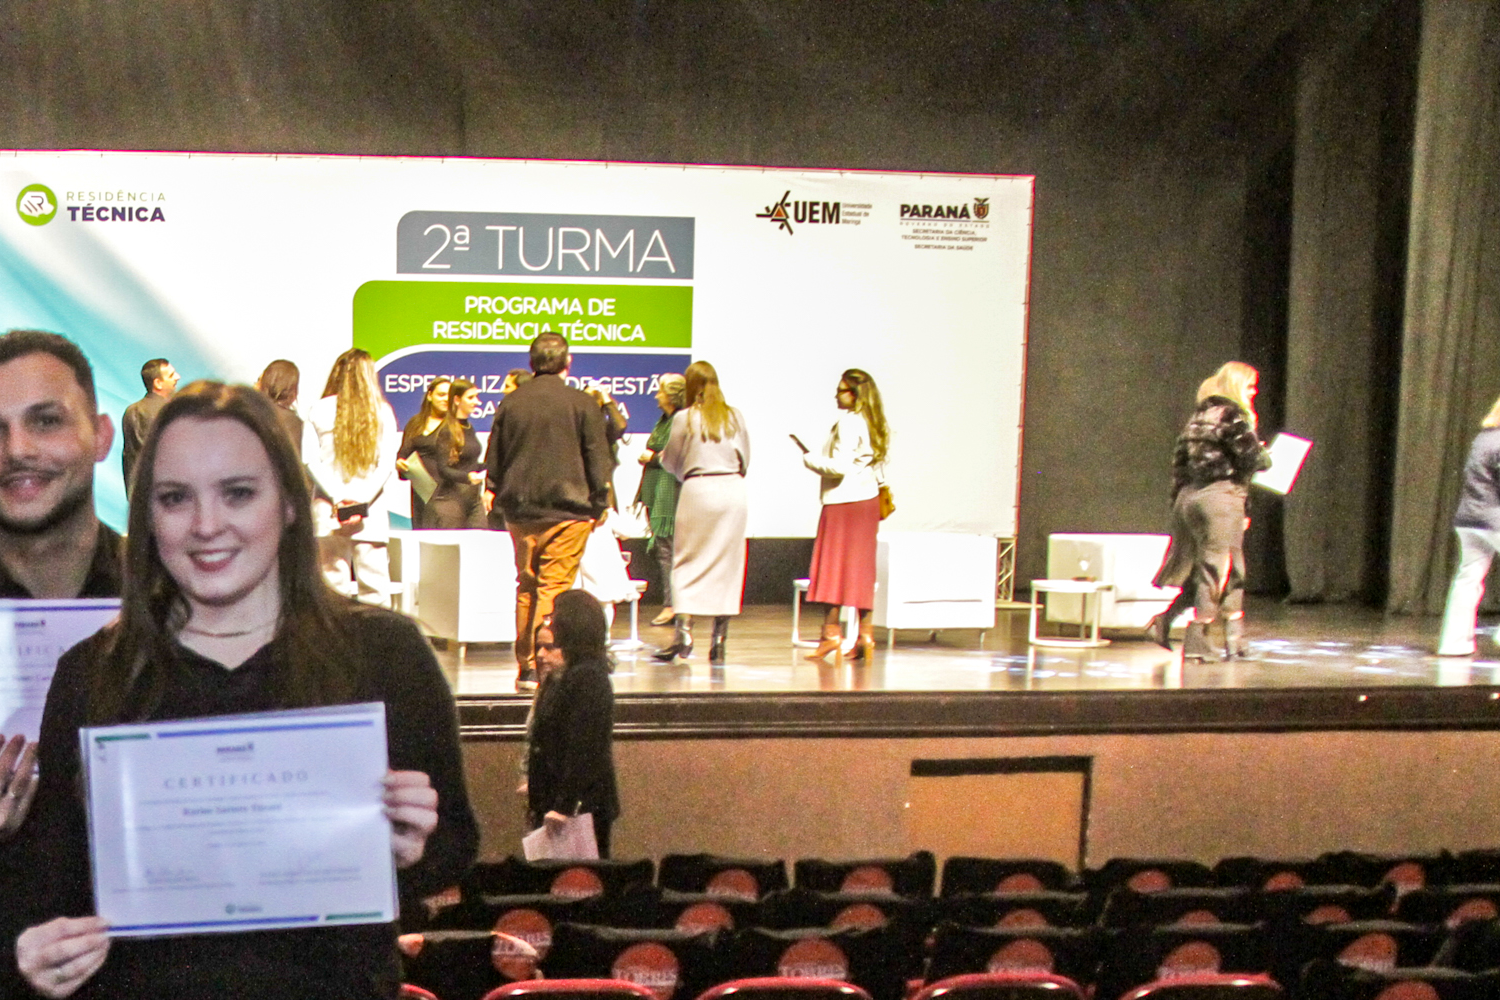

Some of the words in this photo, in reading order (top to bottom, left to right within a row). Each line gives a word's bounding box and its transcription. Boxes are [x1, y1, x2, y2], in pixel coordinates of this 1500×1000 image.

[66, 190, 166, 202] RESIDÊNCIA
[66, 203, 166, 222] TÉCNICA
[793, 200, 841, 225] UEM
[900, 203, 971, 219] PARANÁ
[421, 223, 471, 269] 2ª
[485, 225, 676, 273] TURMA
[464, 295, 584, 315] PROGRAMA
[587, 298, 617, 316] DE
[558, 319, 647, 342] TÉCNICA
[163, 769, 309, 791] CERTIFICADO
